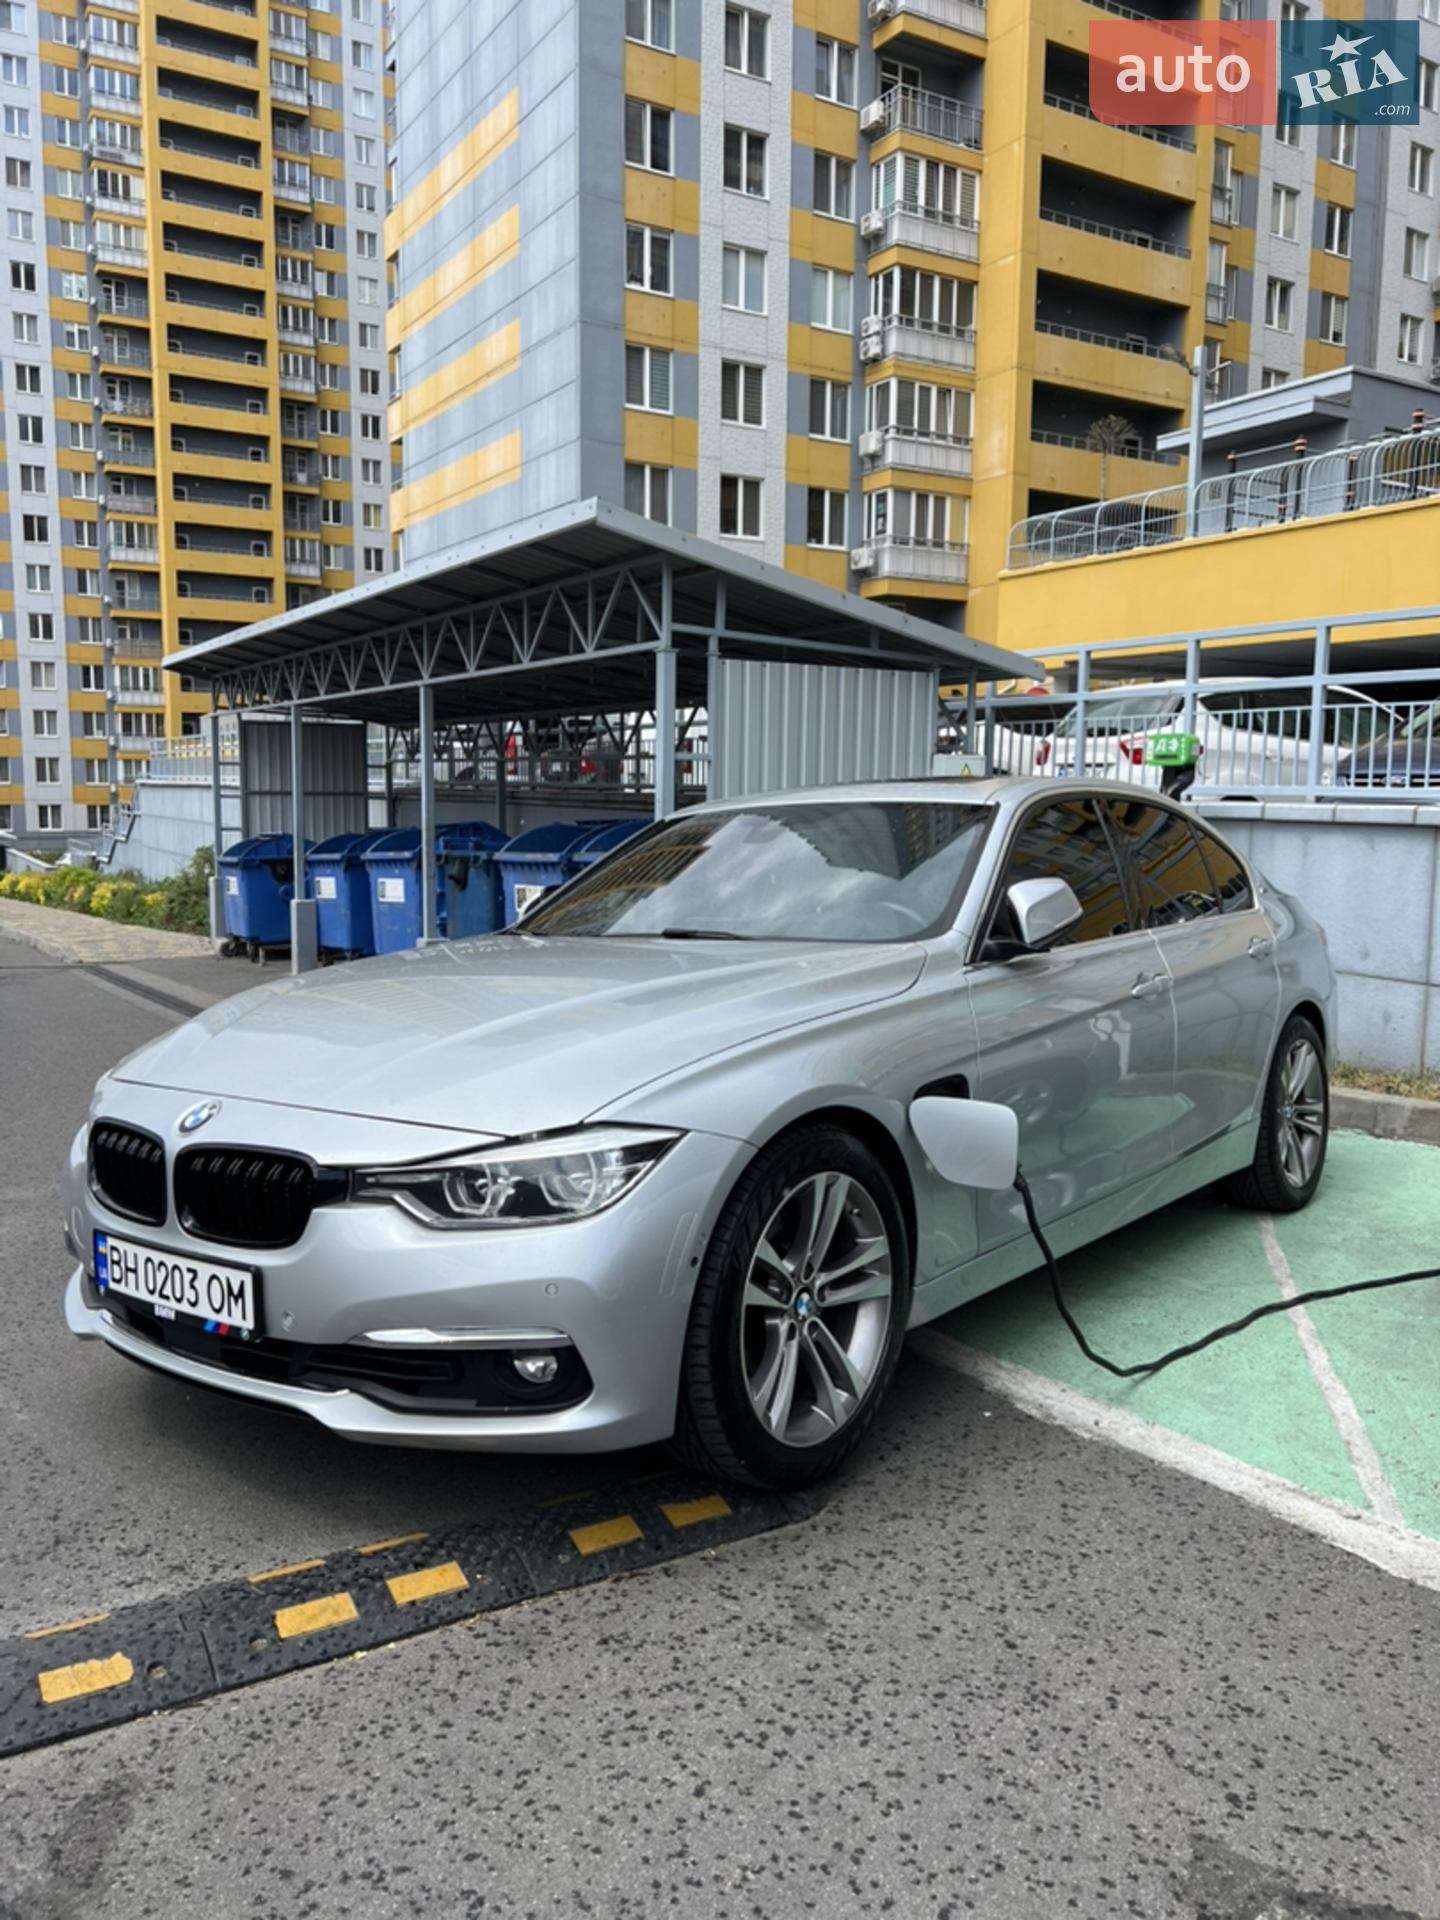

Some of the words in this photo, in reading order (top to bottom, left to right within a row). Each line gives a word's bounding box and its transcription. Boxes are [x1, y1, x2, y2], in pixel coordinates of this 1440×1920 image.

[109, 1244, 139, 1292] BH
[144, 1256, 200, 1308] 0203
[207, 1273, 247, 1322] OM
